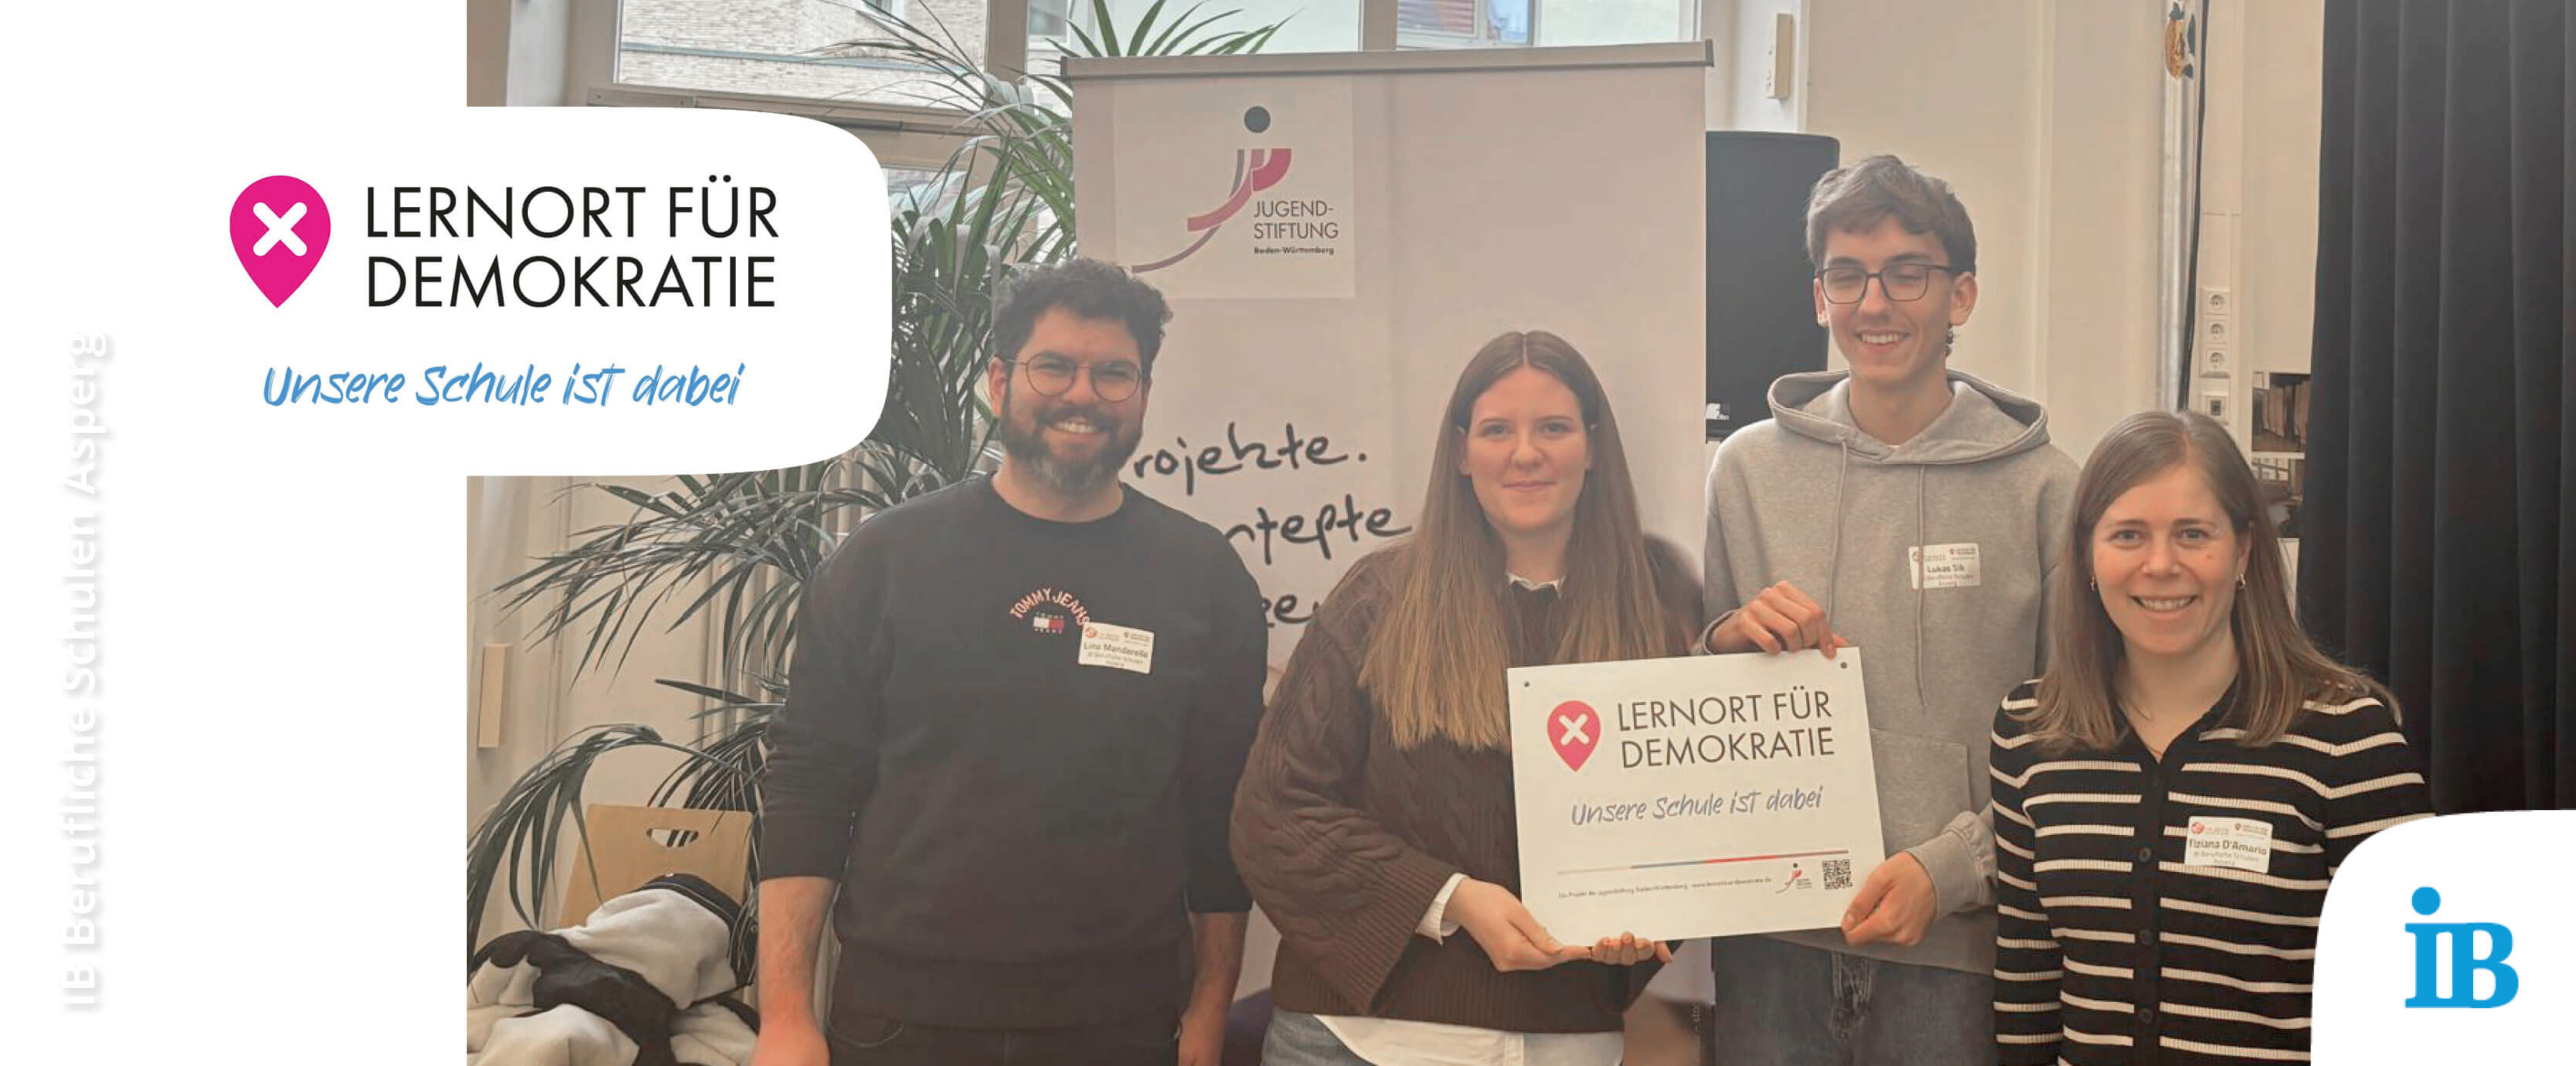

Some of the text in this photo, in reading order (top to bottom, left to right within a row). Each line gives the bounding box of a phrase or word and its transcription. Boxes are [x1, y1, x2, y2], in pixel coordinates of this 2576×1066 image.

[1254, 200, 1335, 217] JUGEND-
[1254, 222, 1339, 239] STIFTUNG
[1134, 422, 1366, 496] rojekte.
[1009, 587, 1051, 618] TOMMY
[1053, 590, 1091, 625] JEANS
[1618, 685, 1832, 731] LERNORT FÜR
[1621, 727, 1836, 768] DEMOKRATIE
[1571, 785, 1823, 826] Unsere Schule ist dabei
